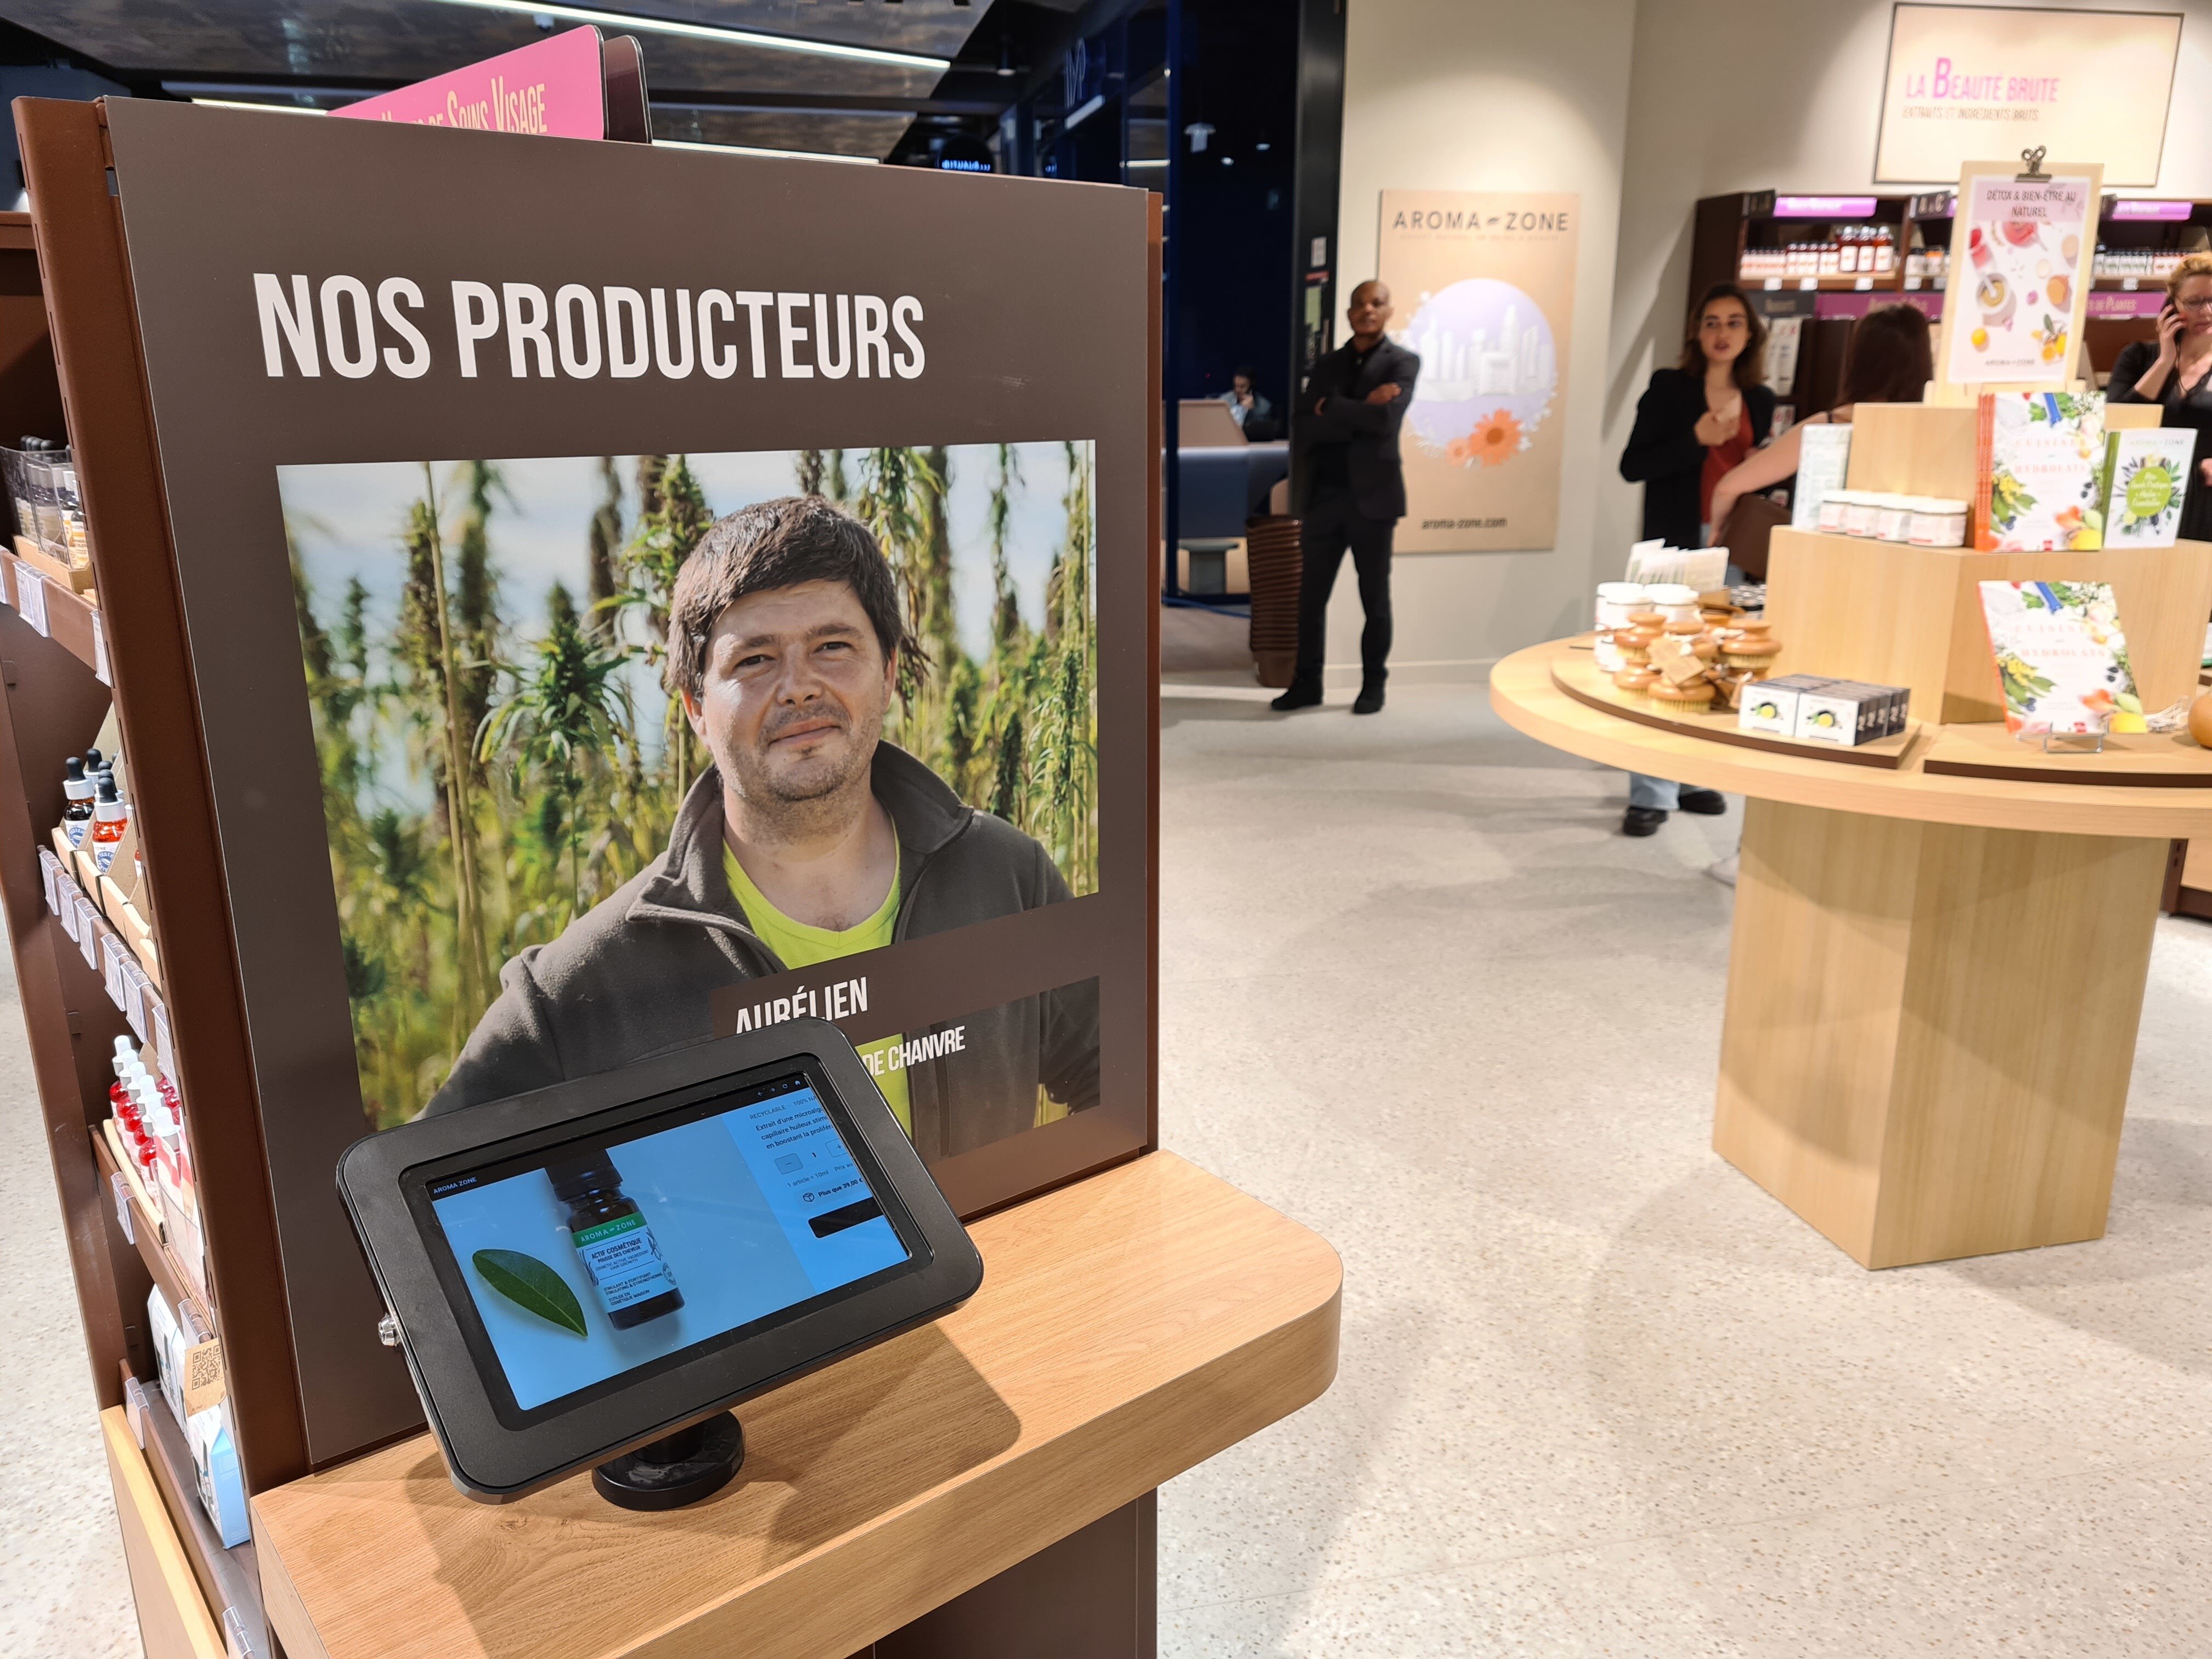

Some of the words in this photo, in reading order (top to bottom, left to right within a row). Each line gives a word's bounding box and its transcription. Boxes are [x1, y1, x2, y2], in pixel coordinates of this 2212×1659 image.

[490, 75, 548, 134] VISAGE
[1392, 211, 1481, 230] AROMA
[1506, 212, 1569, 231] ZONE
[253, 273, 431, 379] NOS
[451, 280, 926, 379] PRODUCTEURS
[736, 977, 868, 1034] AURÉLIEN
[862, 1049, 885, 1076] DE
[888, 1025, 966, 1071] CHANVRE
[749, 1104, 787, 1120] RECYCLABLE
[755, 1120, 776, 1131] Extrait
[777, 1114, 794, 1124] d'une
[761, 1127, 790, 1140] capillaire
[789, 1121, 812, 1131] huileux
[775, 1134, 803, 1147] boostant
[433, 1183, 459, 1194] AROMA
[458, 1176, 477, 1187] ZONE
[793, 1177, 810, 1186] article
[815, 1170, 830, 1178] 10ml
[843, 1179, 859, 1189] 39,00
[580, 1229, 609, 1243] AROMA
[614, 1219, 636, 1231] ZONE
[591, 1249, 606, 1260] ACTIF
[606, 1238, 642, 1254] COSMÉTIQUE
[597, 1255, 613, 1263] POUSSE
